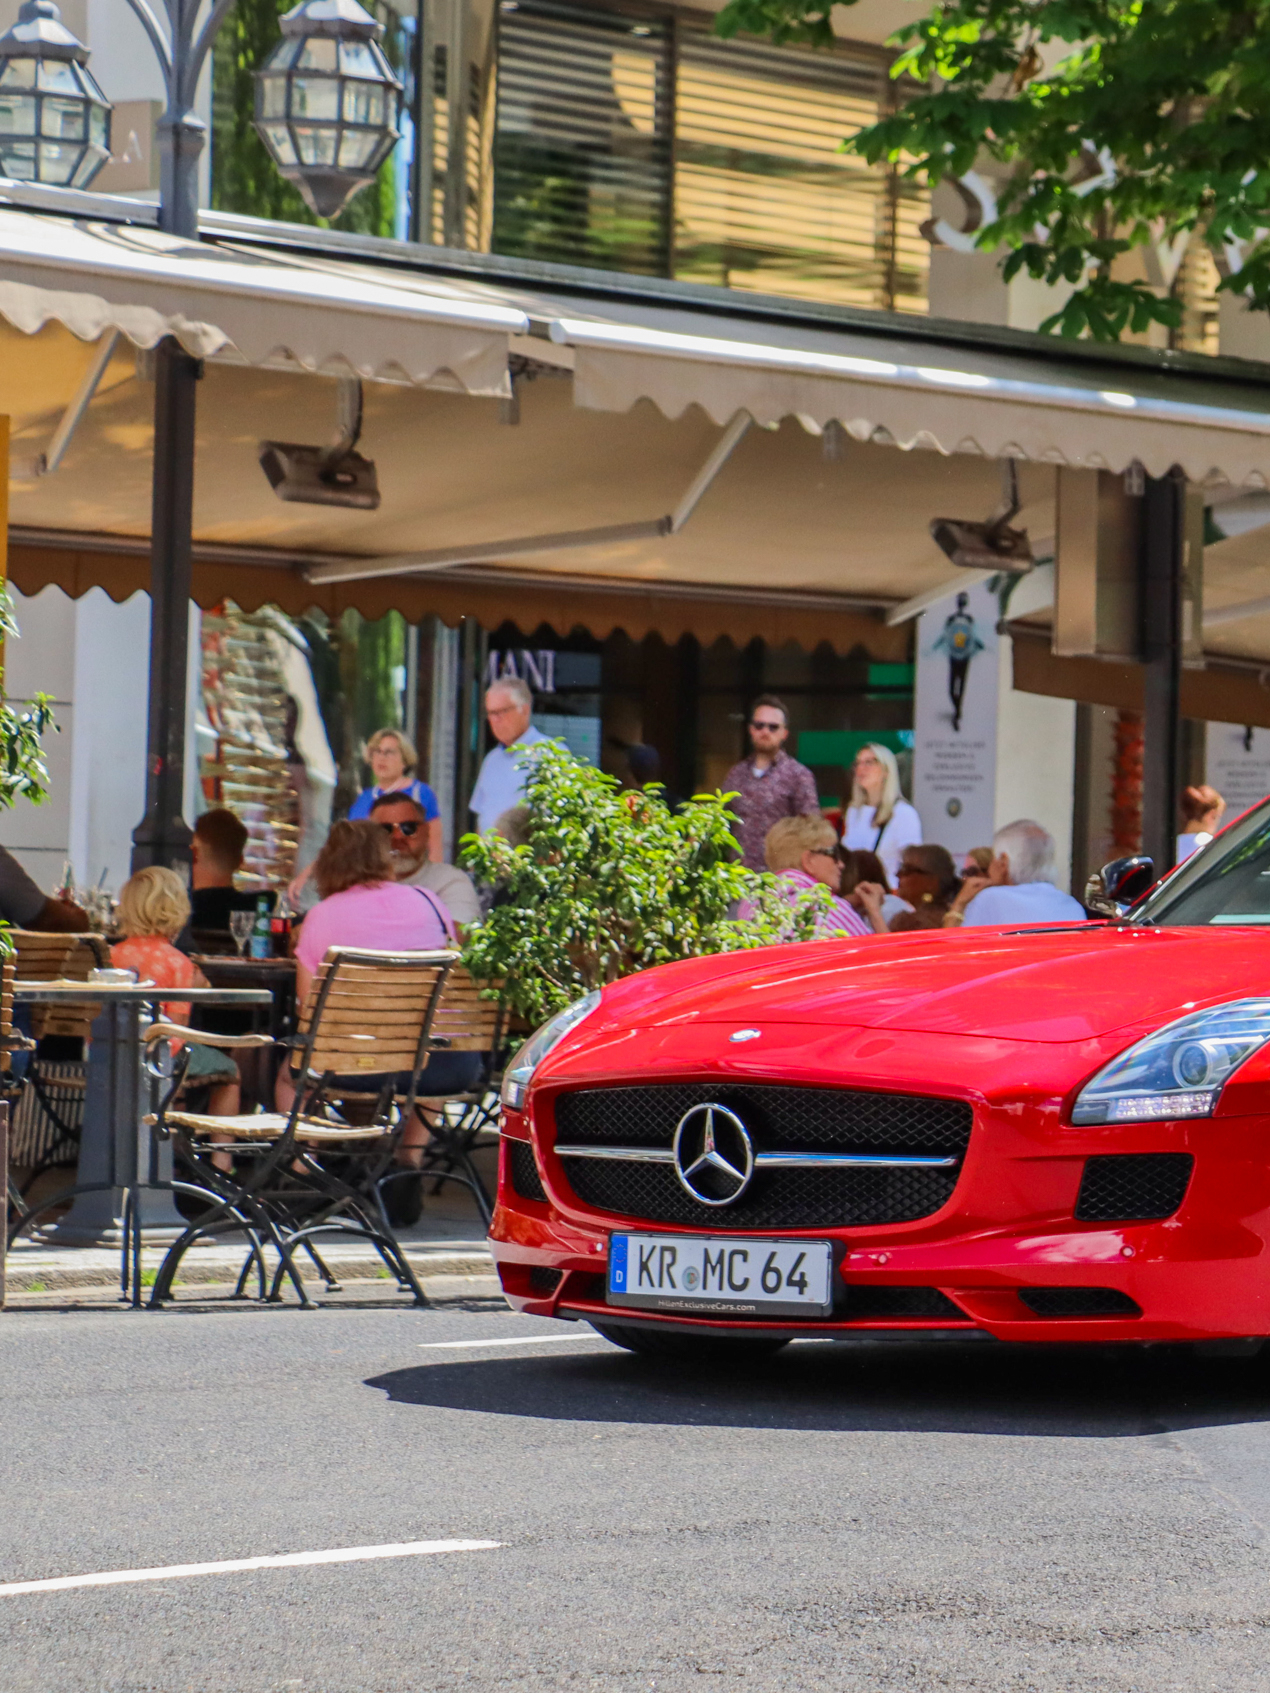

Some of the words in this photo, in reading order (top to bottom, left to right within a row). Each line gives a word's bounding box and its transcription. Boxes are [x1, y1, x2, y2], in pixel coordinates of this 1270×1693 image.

[615, 1270, 624, 1283] D
[638, 1244, 677, 1289] KR
[702, 1247, 750, 1292] MC
[761, 1251, 808, 1295] 64
